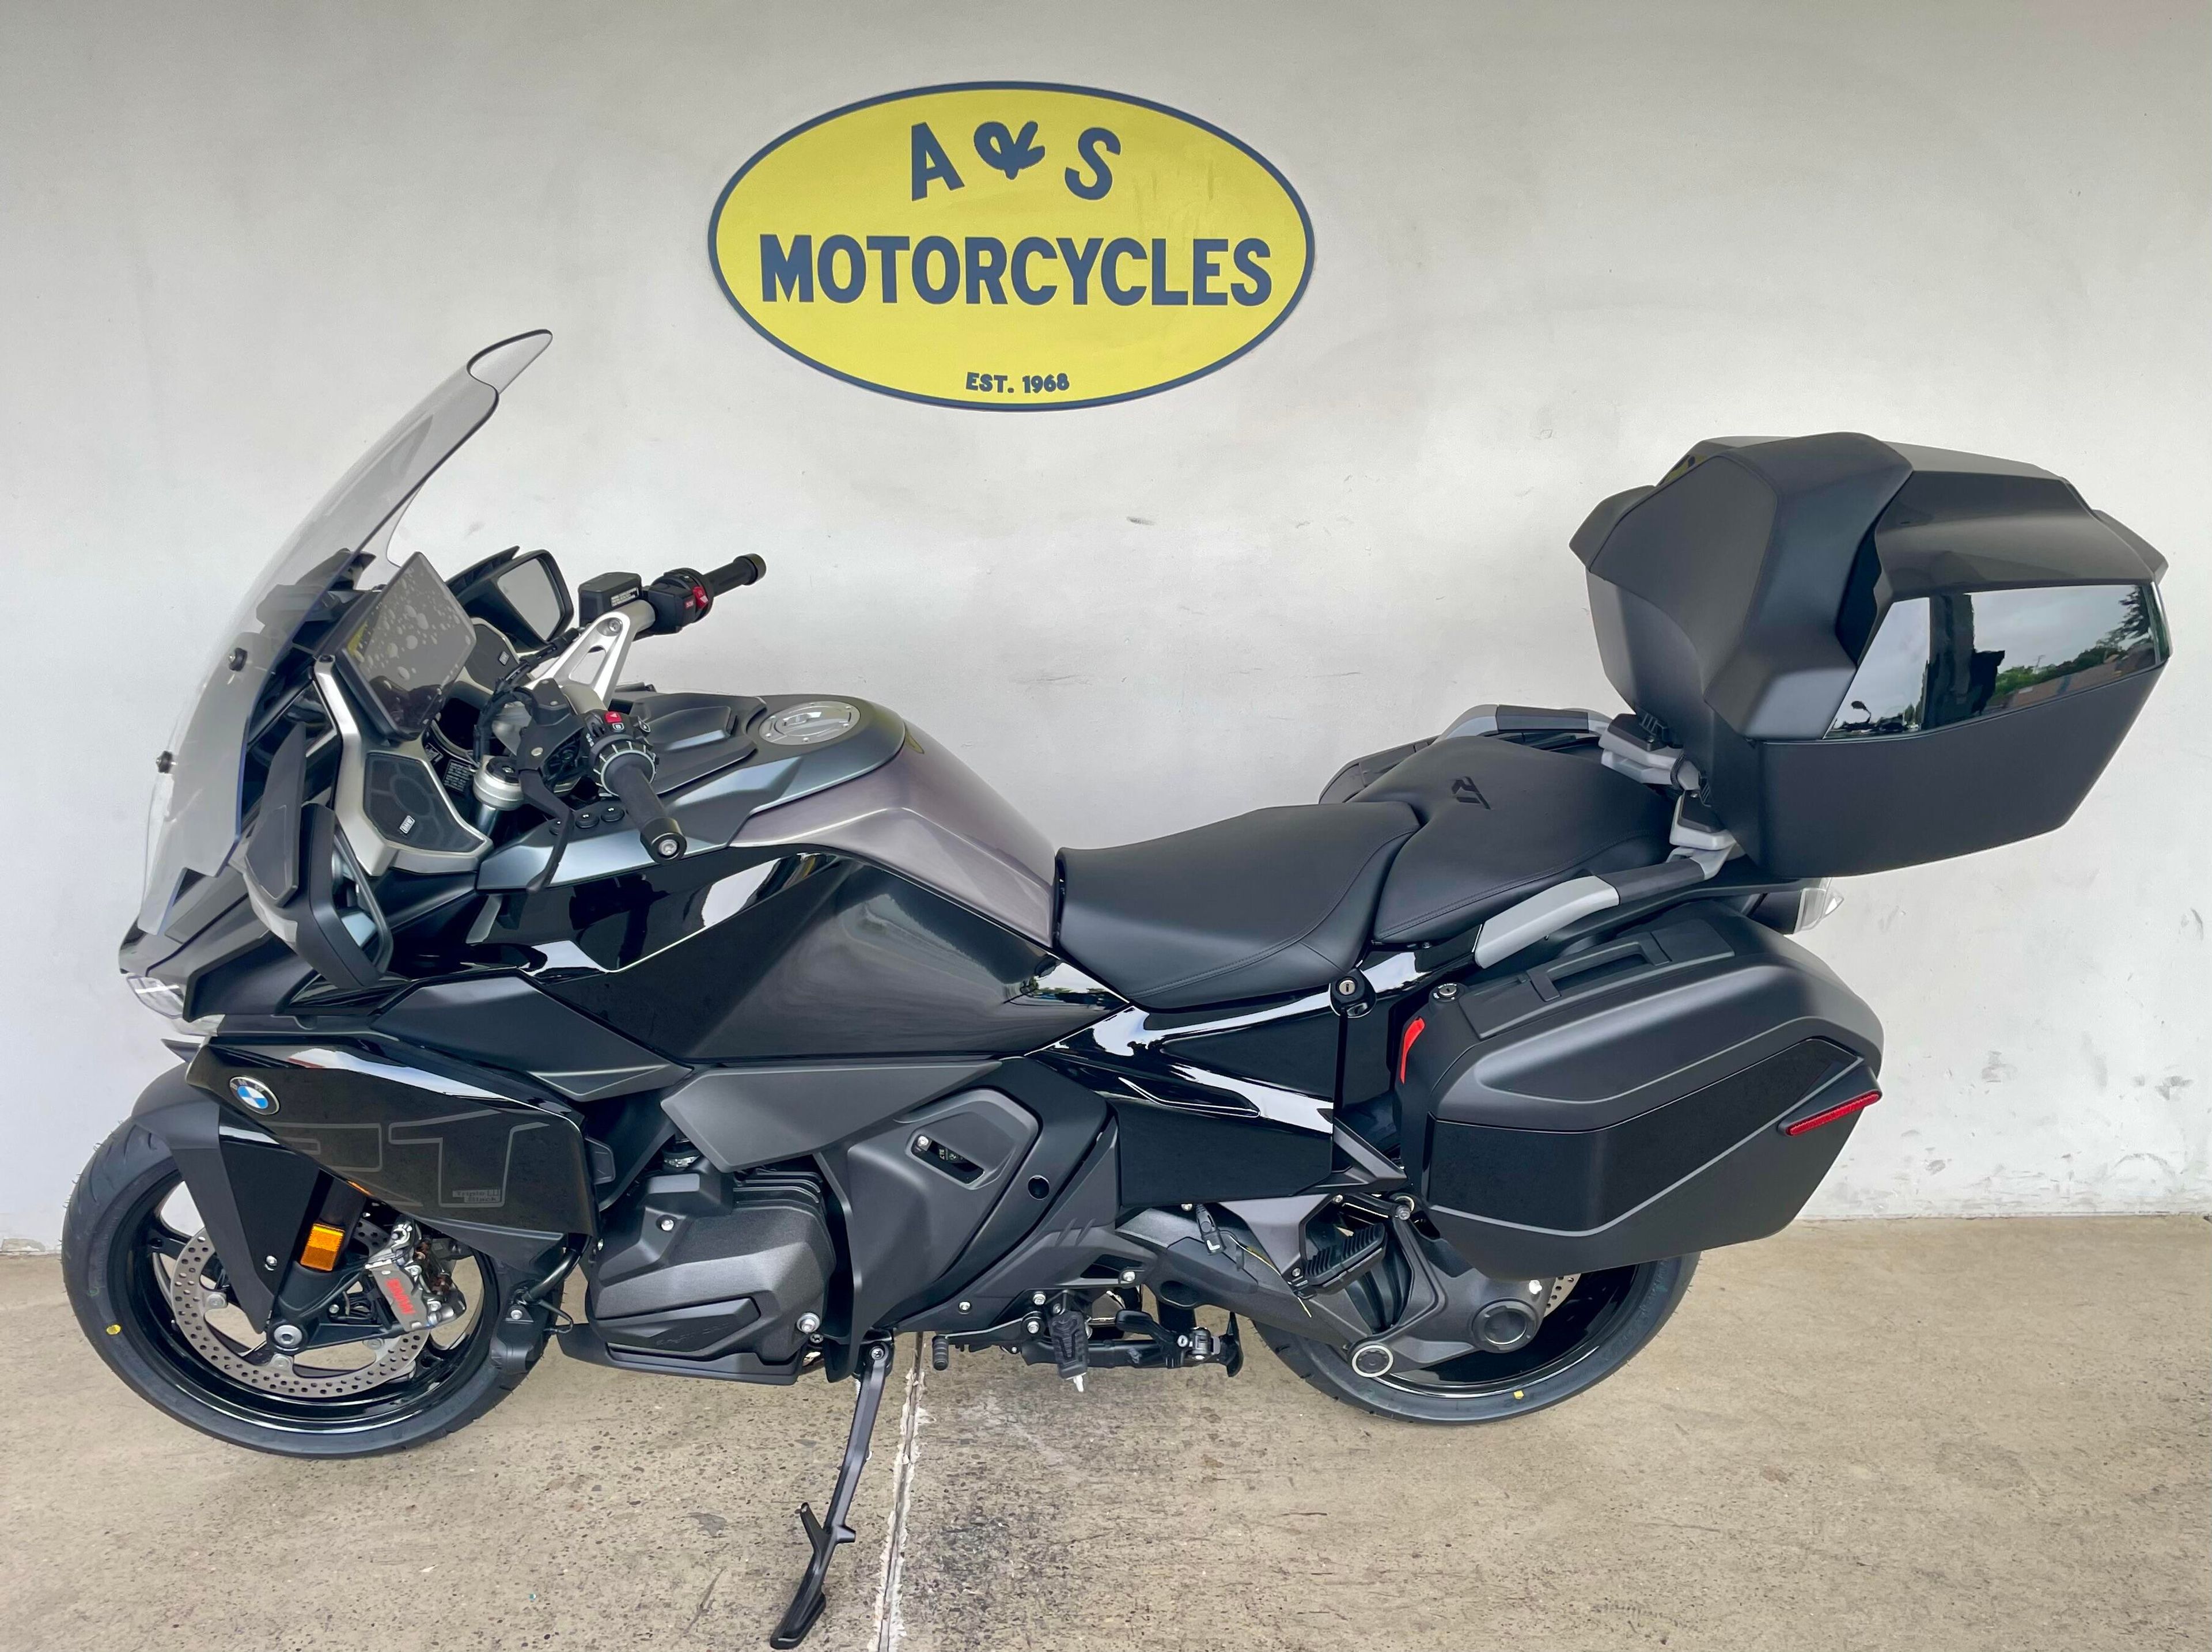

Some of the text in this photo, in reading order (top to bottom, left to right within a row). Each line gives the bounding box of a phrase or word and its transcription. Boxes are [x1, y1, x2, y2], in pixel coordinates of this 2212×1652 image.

[911, 123, 964, 201] A
[1065, 127, 1121, 200] S
[760, 234, 1272, 306] MOTORCYCLES
[966, 372, 1070, 393] EST. 1968
[1206, 1240, 1221, 1251] L
